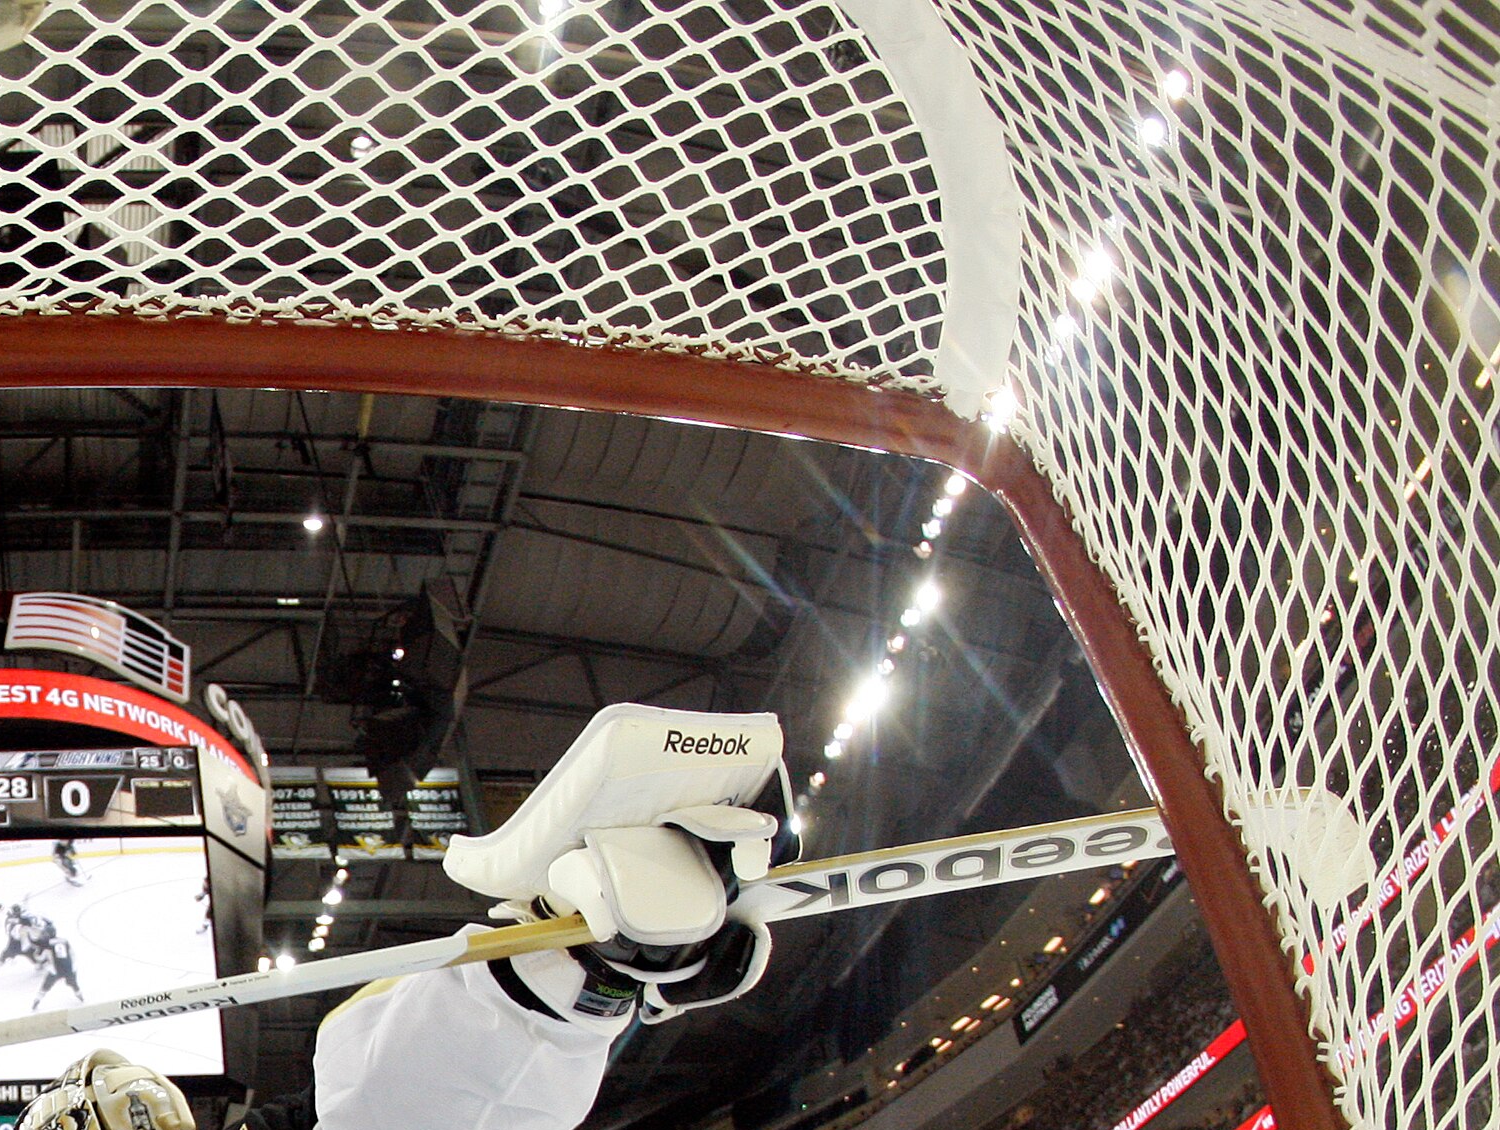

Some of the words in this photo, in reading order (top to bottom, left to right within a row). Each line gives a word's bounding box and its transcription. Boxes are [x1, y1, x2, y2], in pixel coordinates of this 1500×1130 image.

[45, 686, 79, 708] 4G
[83, 692, 188, 744] NETWORK
[663, 729, 751, 755] Reebok
[139, 755, 159, 768] 25
[173, 755, 185, 767] 0
[60, 780, 90, 817] 0
[776, 822, 1175, 912] eebok
[120, 991, 173, 1010] Reebok
[1160, 1050, 1216, 1104] POWERFUL.
